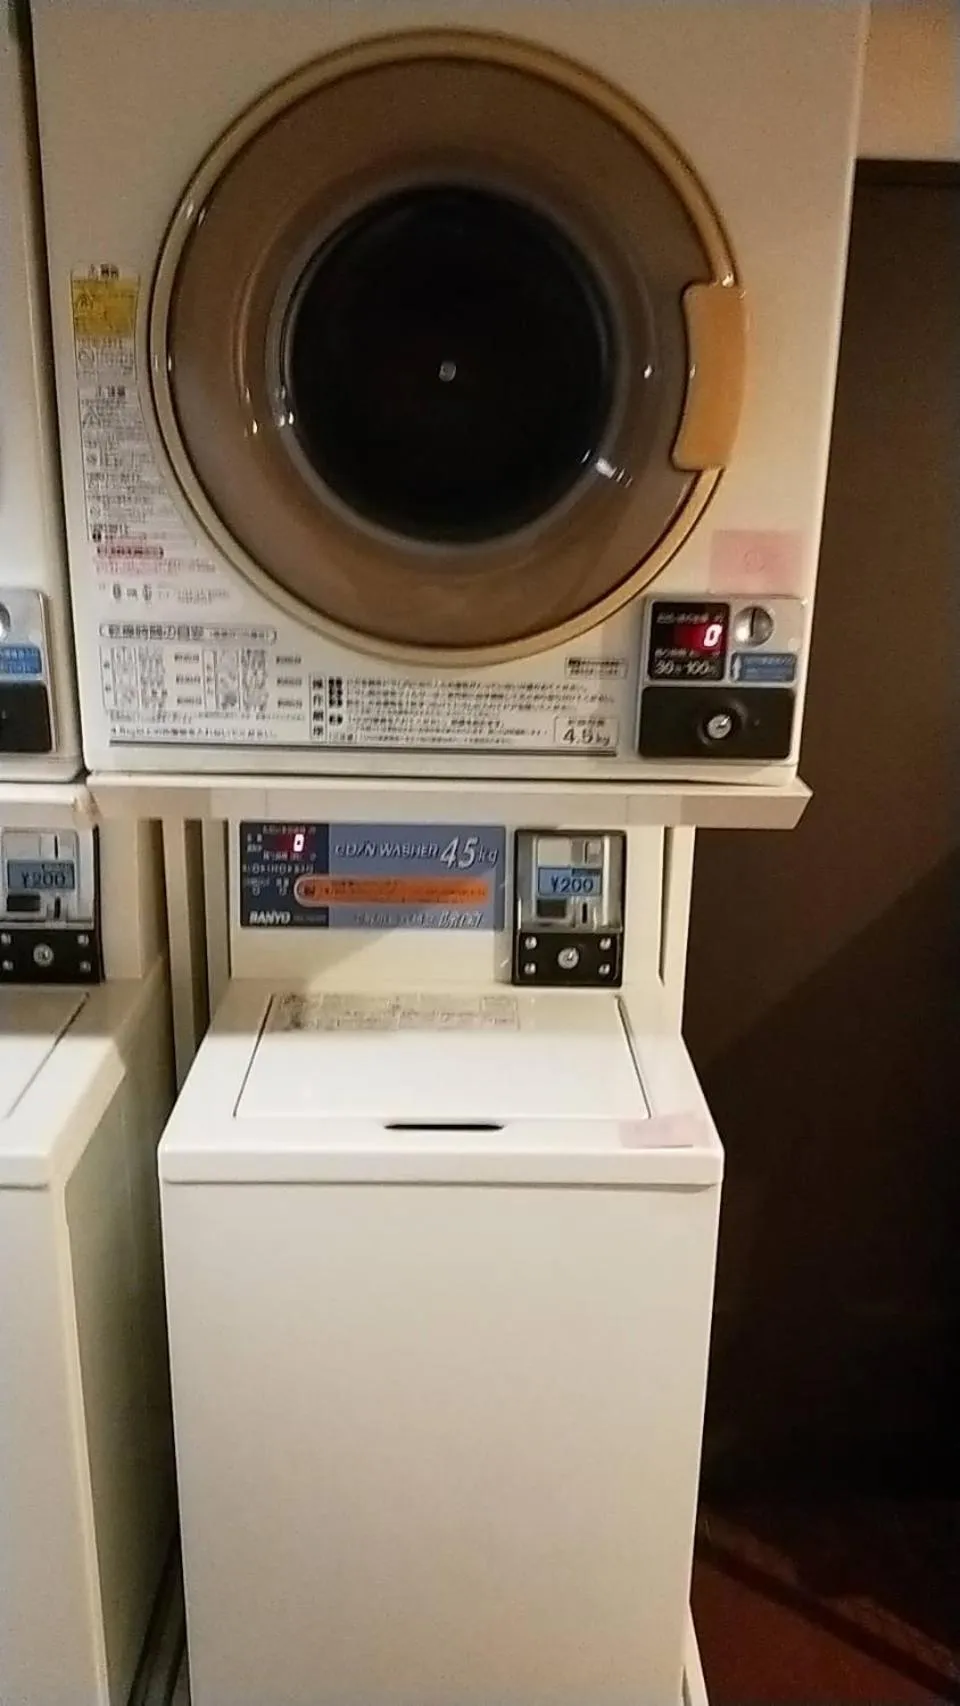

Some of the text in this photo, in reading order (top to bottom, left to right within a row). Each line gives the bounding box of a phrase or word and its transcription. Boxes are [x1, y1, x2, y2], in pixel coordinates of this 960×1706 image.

[703, 624, 722, 647] 0
[293, 833, 304, 852] 0
[550, 876, 594, 893] ¥200
